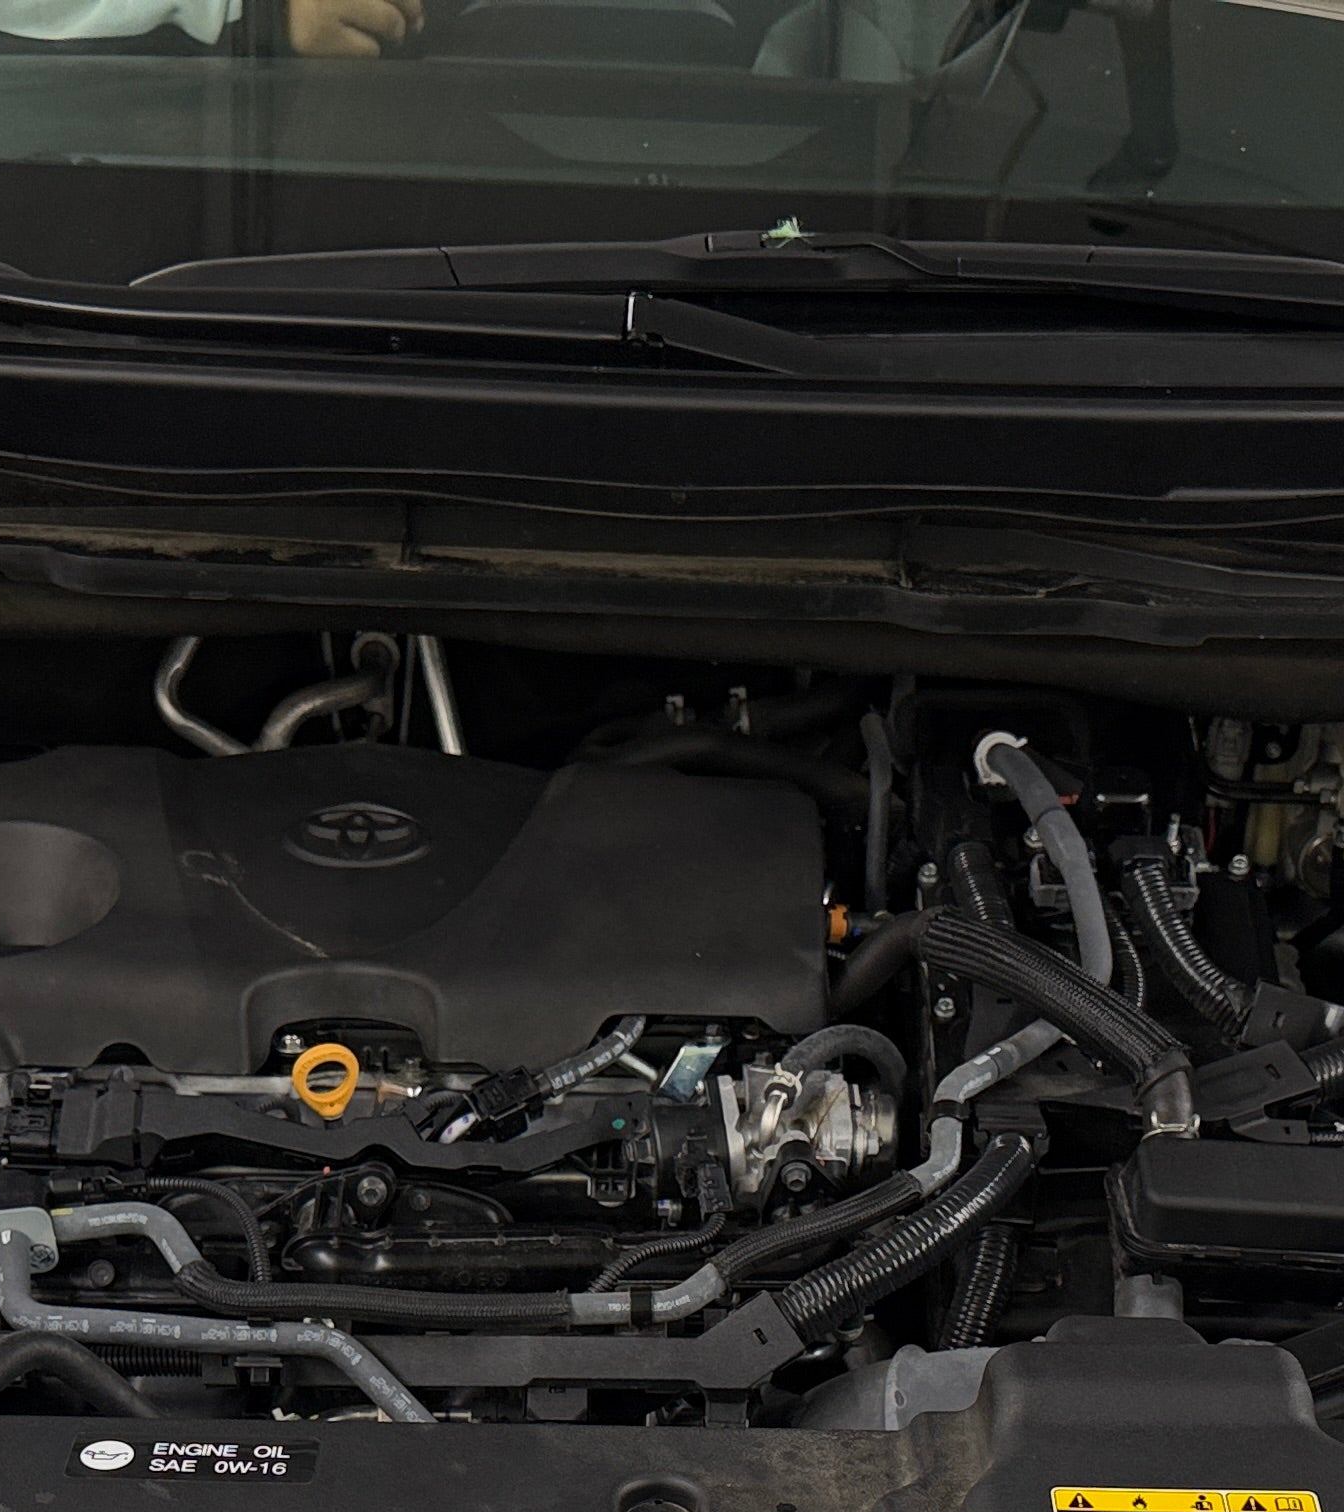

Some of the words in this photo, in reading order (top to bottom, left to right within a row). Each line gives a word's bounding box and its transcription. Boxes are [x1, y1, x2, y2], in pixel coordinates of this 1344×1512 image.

[153, 1442, 238, 1458] ENGINE
[253, 1445, 290, 1459] OIL
[148, 1459, 197, 1473] SAE
[214, 1461, 287, 1475] 0W-16
